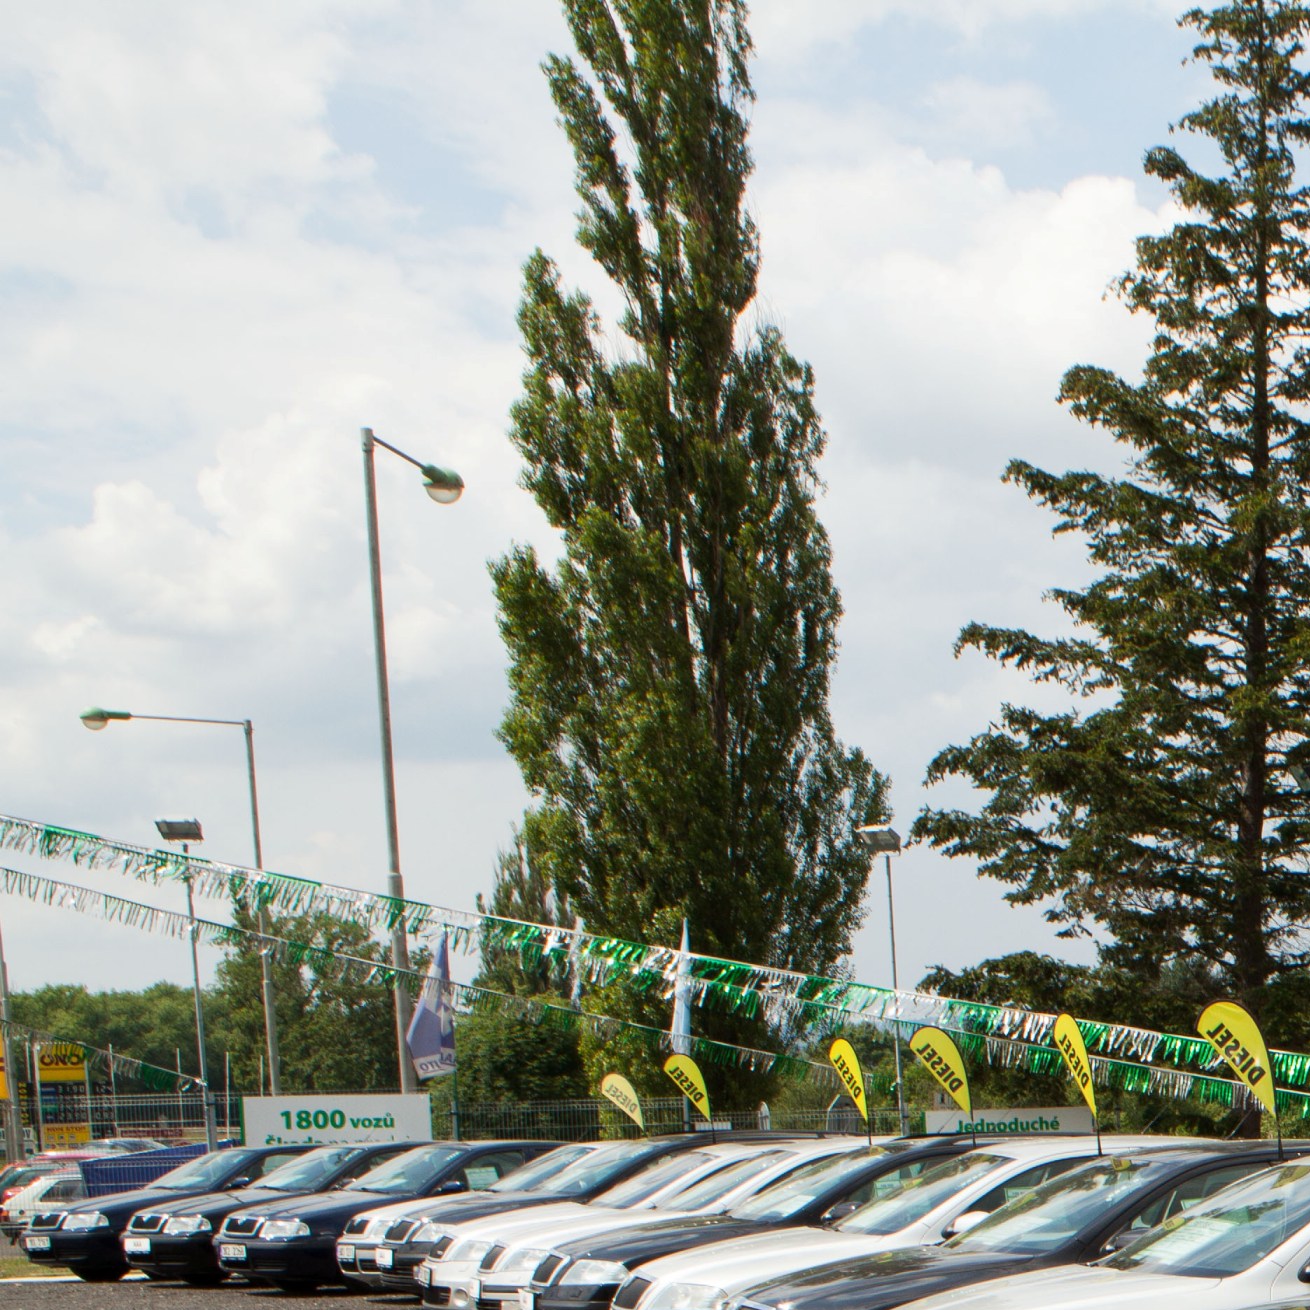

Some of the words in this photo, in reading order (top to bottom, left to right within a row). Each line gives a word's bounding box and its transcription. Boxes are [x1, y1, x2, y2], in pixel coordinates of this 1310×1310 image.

[280, 1109, 346, 1131] 1800
[350, 1112, 396, 1130] vozů
[956, 1116, 1060, 1134] Jednoduché
